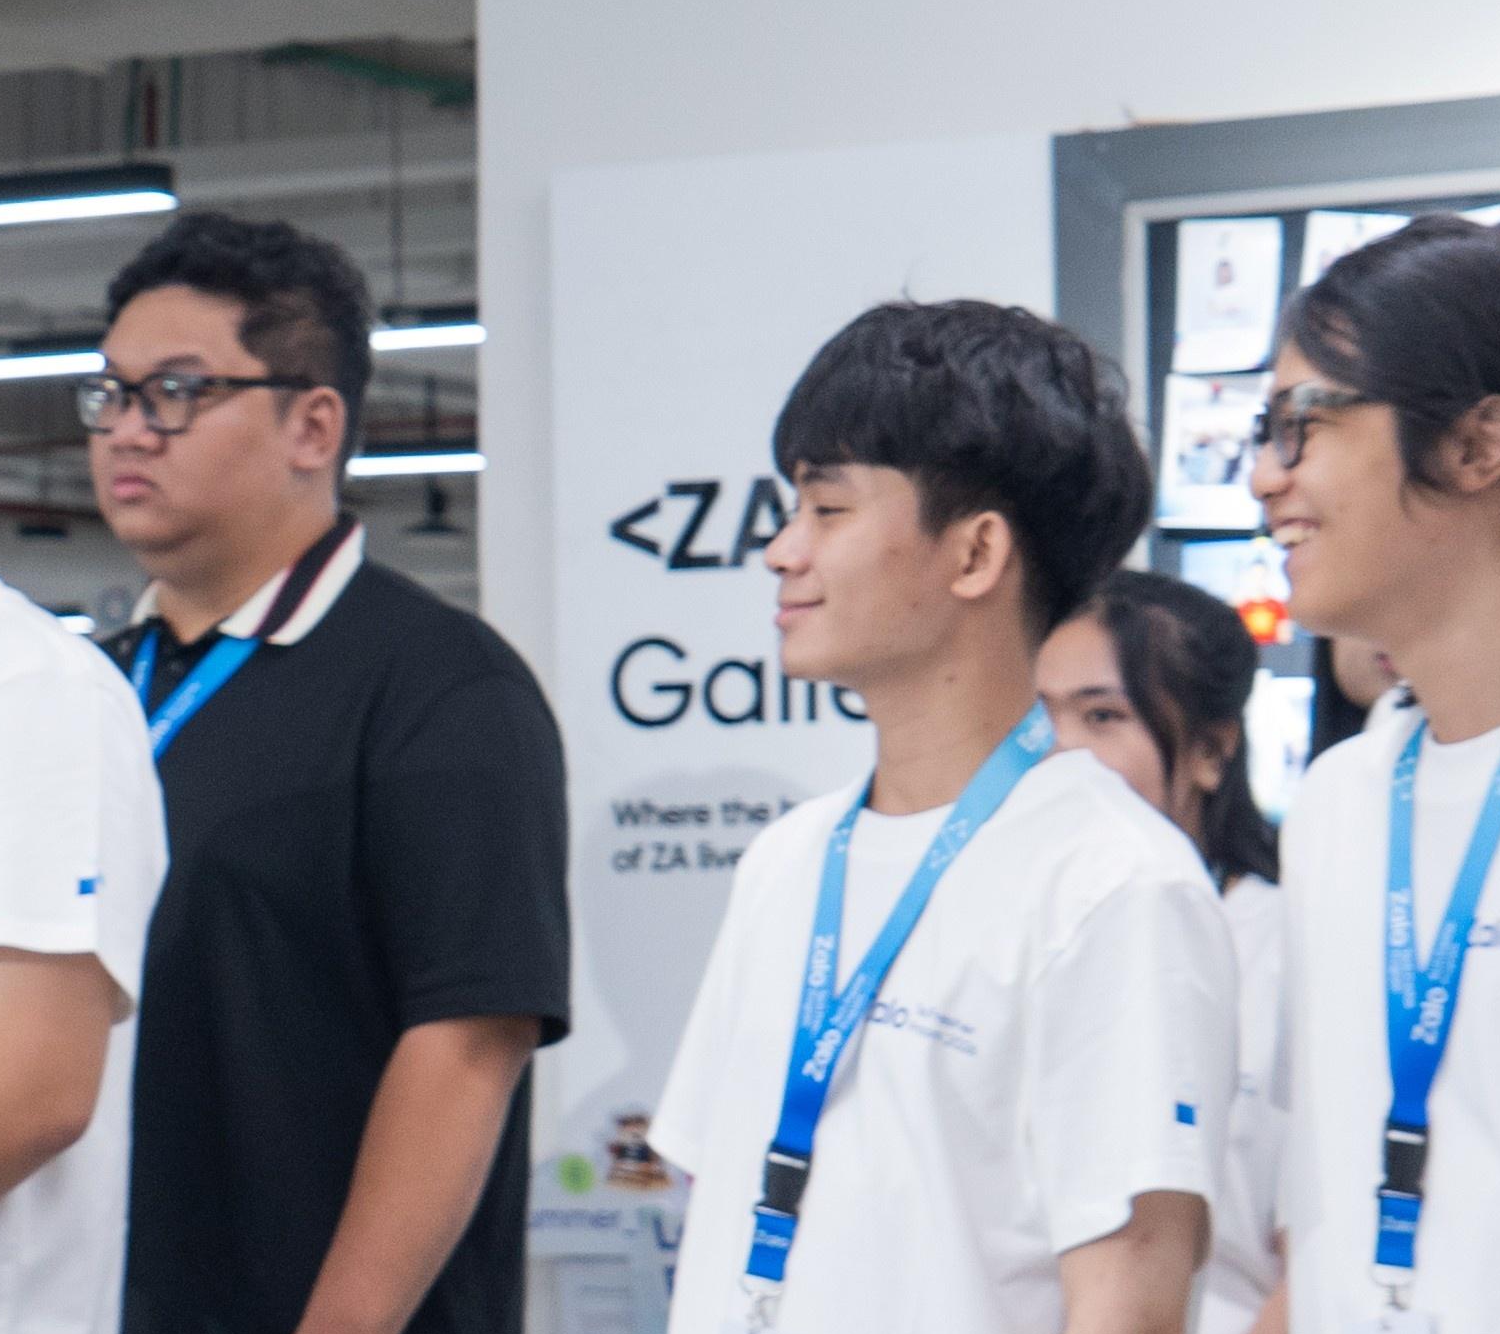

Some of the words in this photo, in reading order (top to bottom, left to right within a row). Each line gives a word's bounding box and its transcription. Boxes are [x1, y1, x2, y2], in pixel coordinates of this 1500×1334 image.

[611, 798, 707, 827] Where
[719, 797, 770, 824] the
[612, 844, 642, 872] of
[652, 843, 688, 872] ZA
[866, 999, 908, 1028] alo
[1410, 986, 1449, 1045] Zalo
[801, 1028, 841, 1082] Zalo
